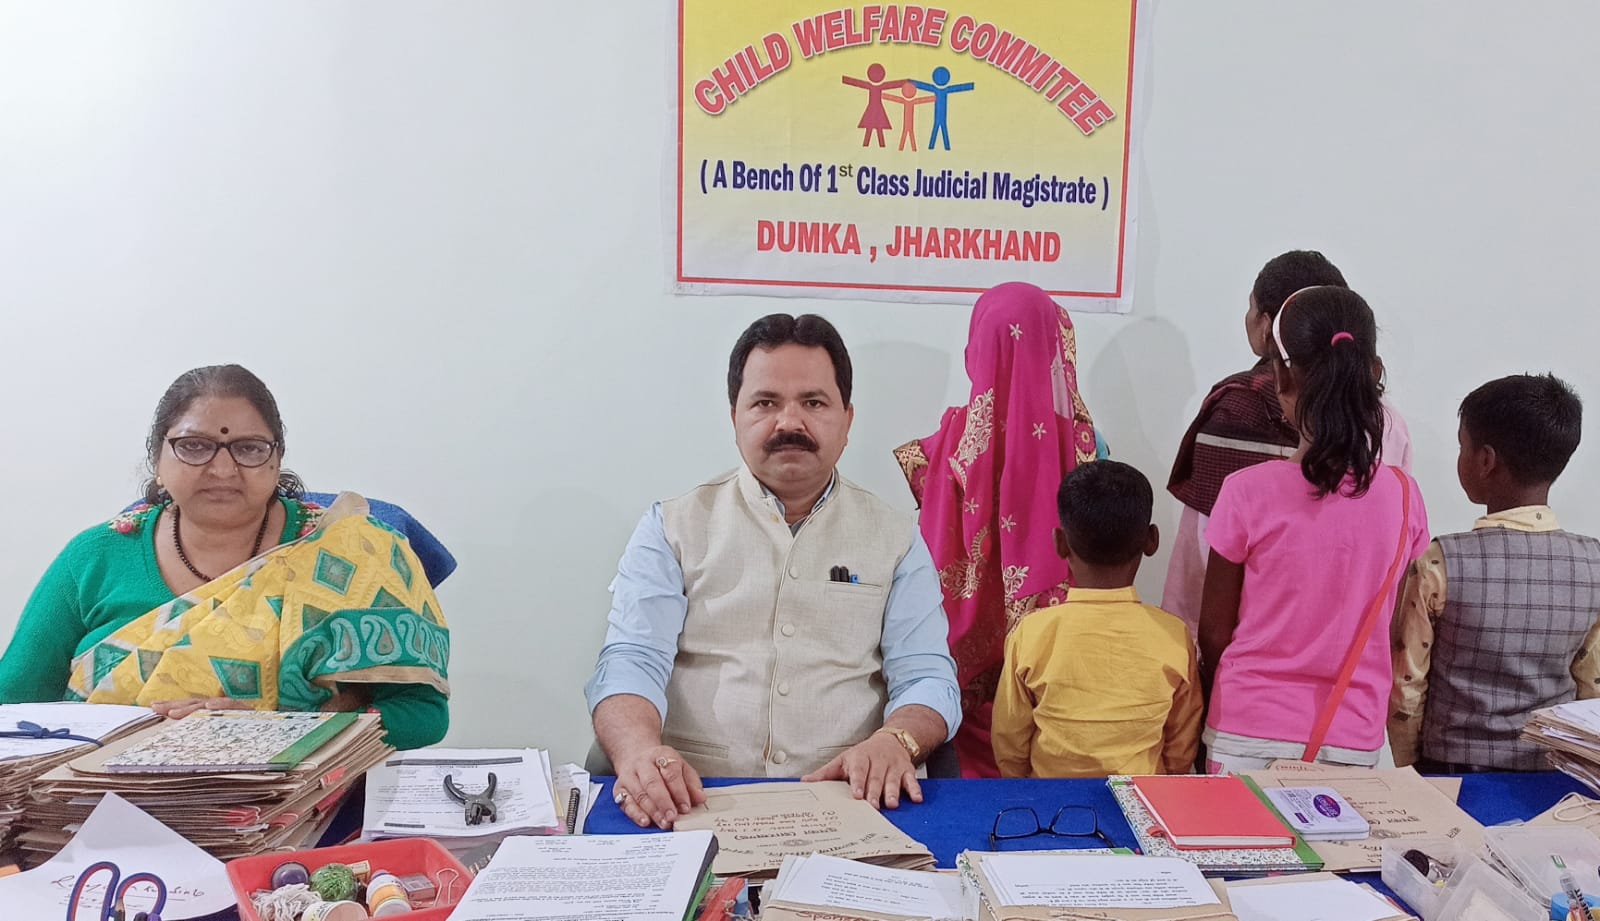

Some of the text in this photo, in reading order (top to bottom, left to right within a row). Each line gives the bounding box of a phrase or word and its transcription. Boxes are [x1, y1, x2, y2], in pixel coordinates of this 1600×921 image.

[694, 5, 1116, 136] CHILD WELFARE COMMITEE
[712, 159, 728, 189] A
[732, 160, 794, 192] Bench
[799, 163, 823, 193] Of
[827, 162, 854, 193] 1st
[856, 165, 910, 197] Class
[912, 168, 988, 200] Judicial
[992, 172, 1097, 208] Magistrate
[756, 219, 862, 256] DUMKA
[886, 226, 1062, 262] JHARKHAND
